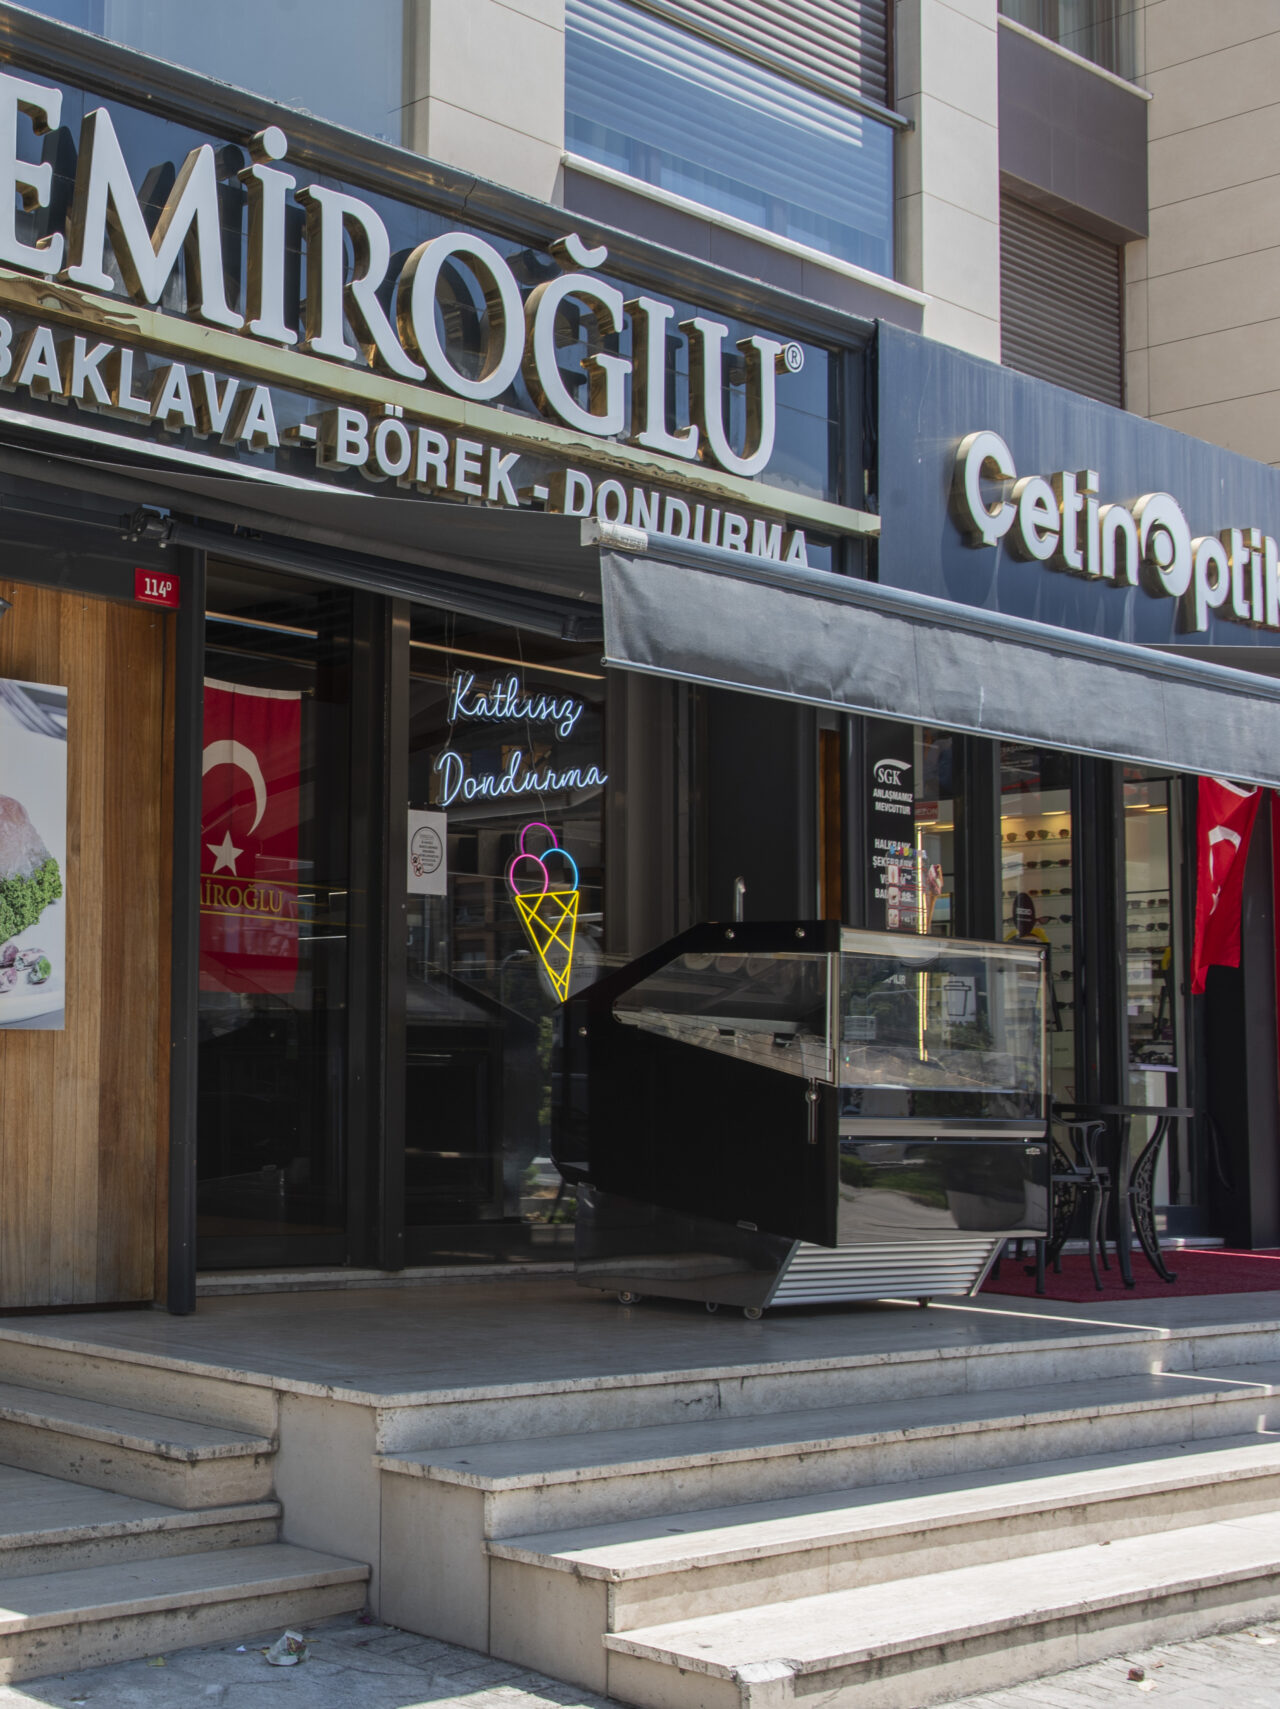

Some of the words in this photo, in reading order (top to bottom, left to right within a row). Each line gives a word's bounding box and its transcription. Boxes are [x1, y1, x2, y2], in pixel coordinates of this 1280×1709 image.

[336, 404, 521, 507] BÖREK
[564, 468, 809, 568] DONDURMA
[451, 674, 583, 737] Katkısız
[437, 750, 609, 807] Dondurma
[877, 767, 902, 786] SGK
[872, 787, 914, 803] ANLAŞMAMIZ
[874, 800, 912, 816] MEVCUTTUR
[200, 879, 285, 913] İROĞLU
